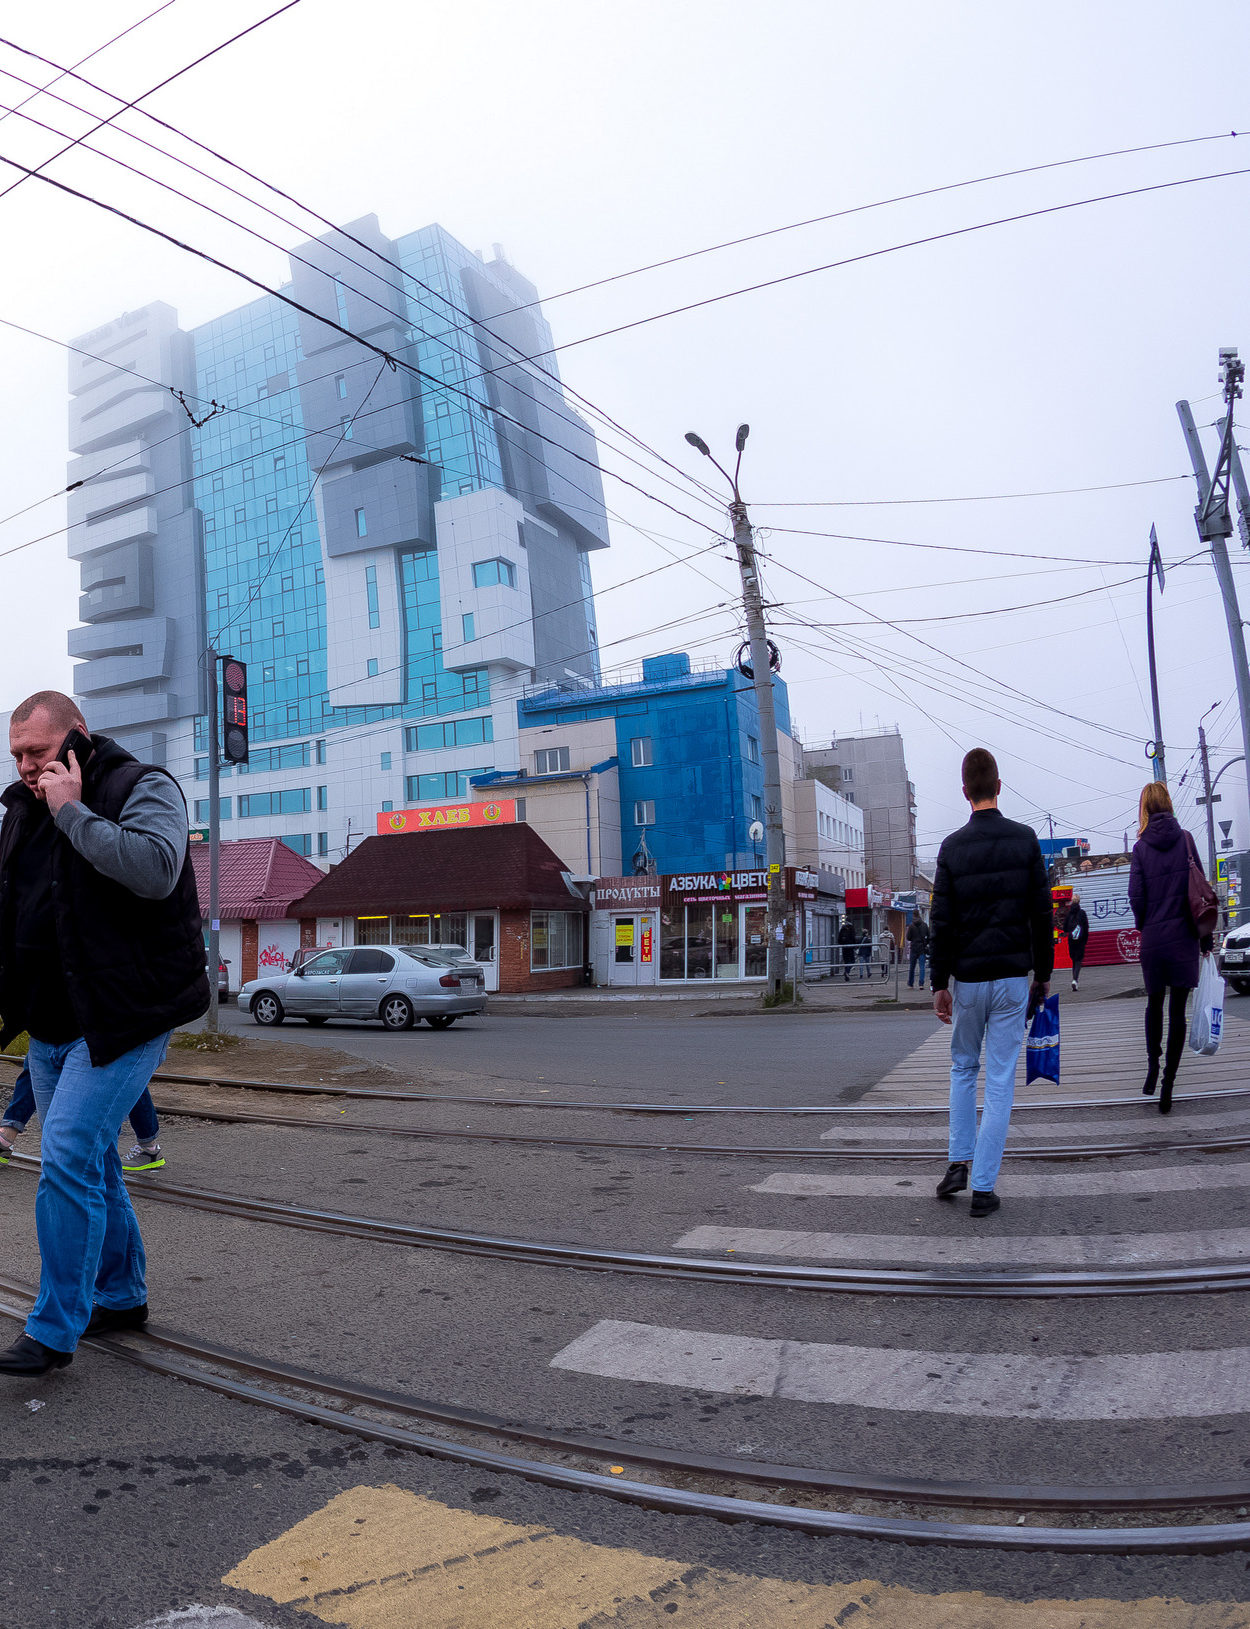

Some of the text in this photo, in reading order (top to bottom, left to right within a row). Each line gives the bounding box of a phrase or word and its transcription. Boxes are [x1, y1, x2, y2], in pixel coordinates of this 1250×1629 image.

[418, 808, 470, 827] ХЛЕБ
[669, 875, 717, 891] АЗБУКА
[731, 872, 769, 890] ЦВЕТО
[596, 886, 661, 901] ПРОДУКТЫ
